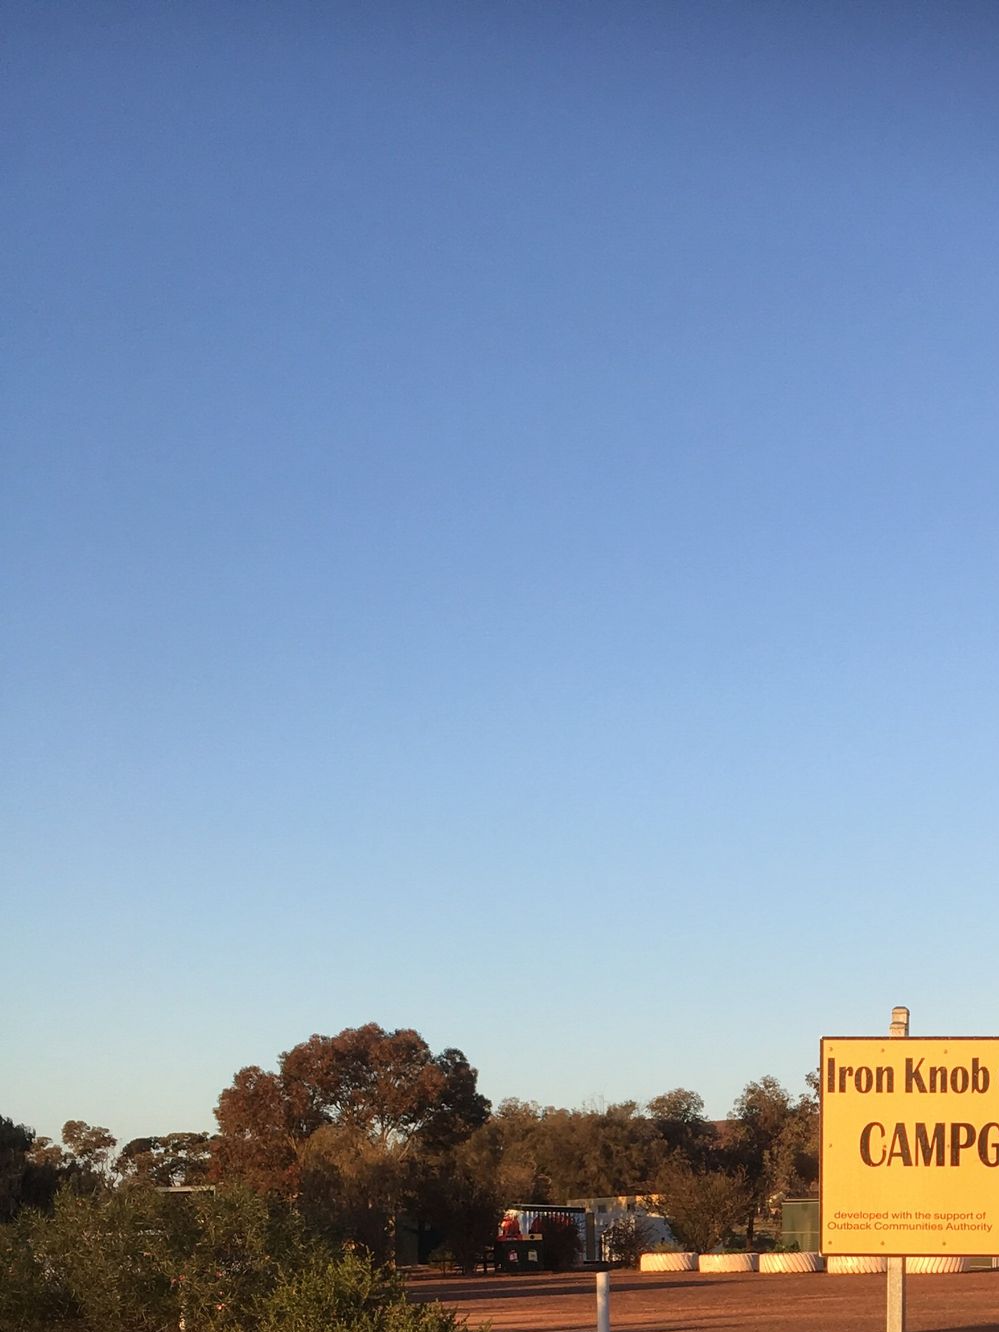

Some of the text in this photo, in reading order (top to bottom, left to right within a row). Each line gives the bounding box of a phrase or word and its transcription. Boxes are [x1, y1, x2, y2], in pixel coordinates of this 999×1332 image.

[827, 1057, 894, 1094] Iron
[905, 1057, 990, 1094] Knob
[833, 1211, 987, 1221] developed with the support of
[827, 1221, 993, 1232] Outback Communities Authority
